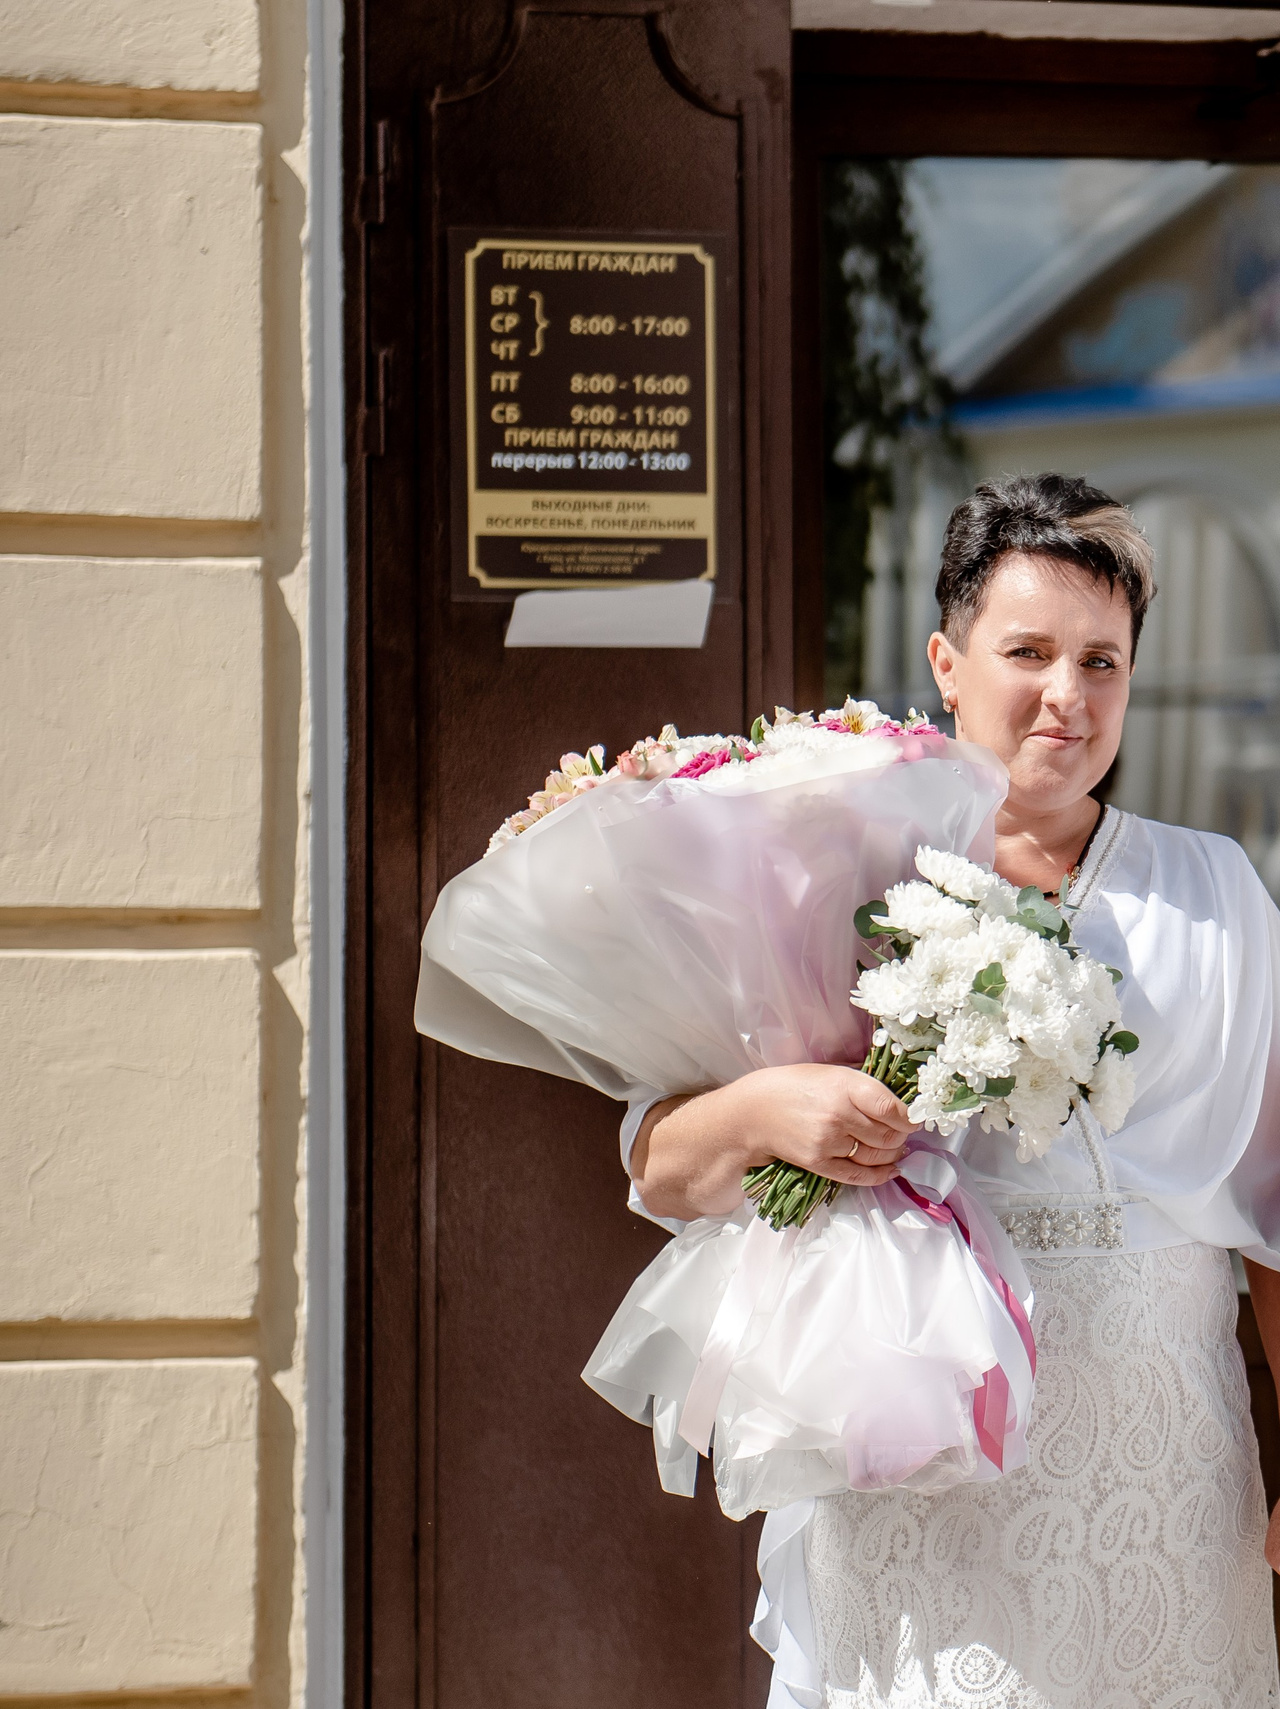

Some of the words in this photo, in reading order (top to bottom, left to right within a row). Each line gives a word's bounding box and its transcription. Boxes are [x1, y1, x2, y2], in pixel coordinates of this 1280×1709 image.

[502, 252, 575, 271] ПРИЕМ
[578, 253, 678, 276] ГРАЖДАН
[490, 284, 519, 306] ВТ
[490, 312, 521, 333] СР
[569, 314, 617, 335] 8:00
[631, 315, 690, 337] 17:00
[490, 339, 520, 361] ЧТ
[490, 370, 521, 393] ПТ
[570, 373, 617, 394] 8:00
[632, 374, 690, 395] 16:00
[490, 402, 522, 424] СБ
[570, 404, 617, 425] 9:00
[633, 405, 691, 427] 11:00
[504, 427, 576, 448] ПРИЕМ
[579, 428, 679, 452] ГРАЖДАН
[491, 452, 576, 473] перерыв
[578, 451, 628, 470] 12:00
[640, 452, 691, 471] 13:00
[531, 500, 613, 514] ВЫХОДНЫЕ
[616, 500, 650, 515] ДНИ:
[486, 516, 587, 531] ВОСКРЕСЕНЬЕ,
[591, 518, 696, 533] ПОНЕДЕЛЬНИК
